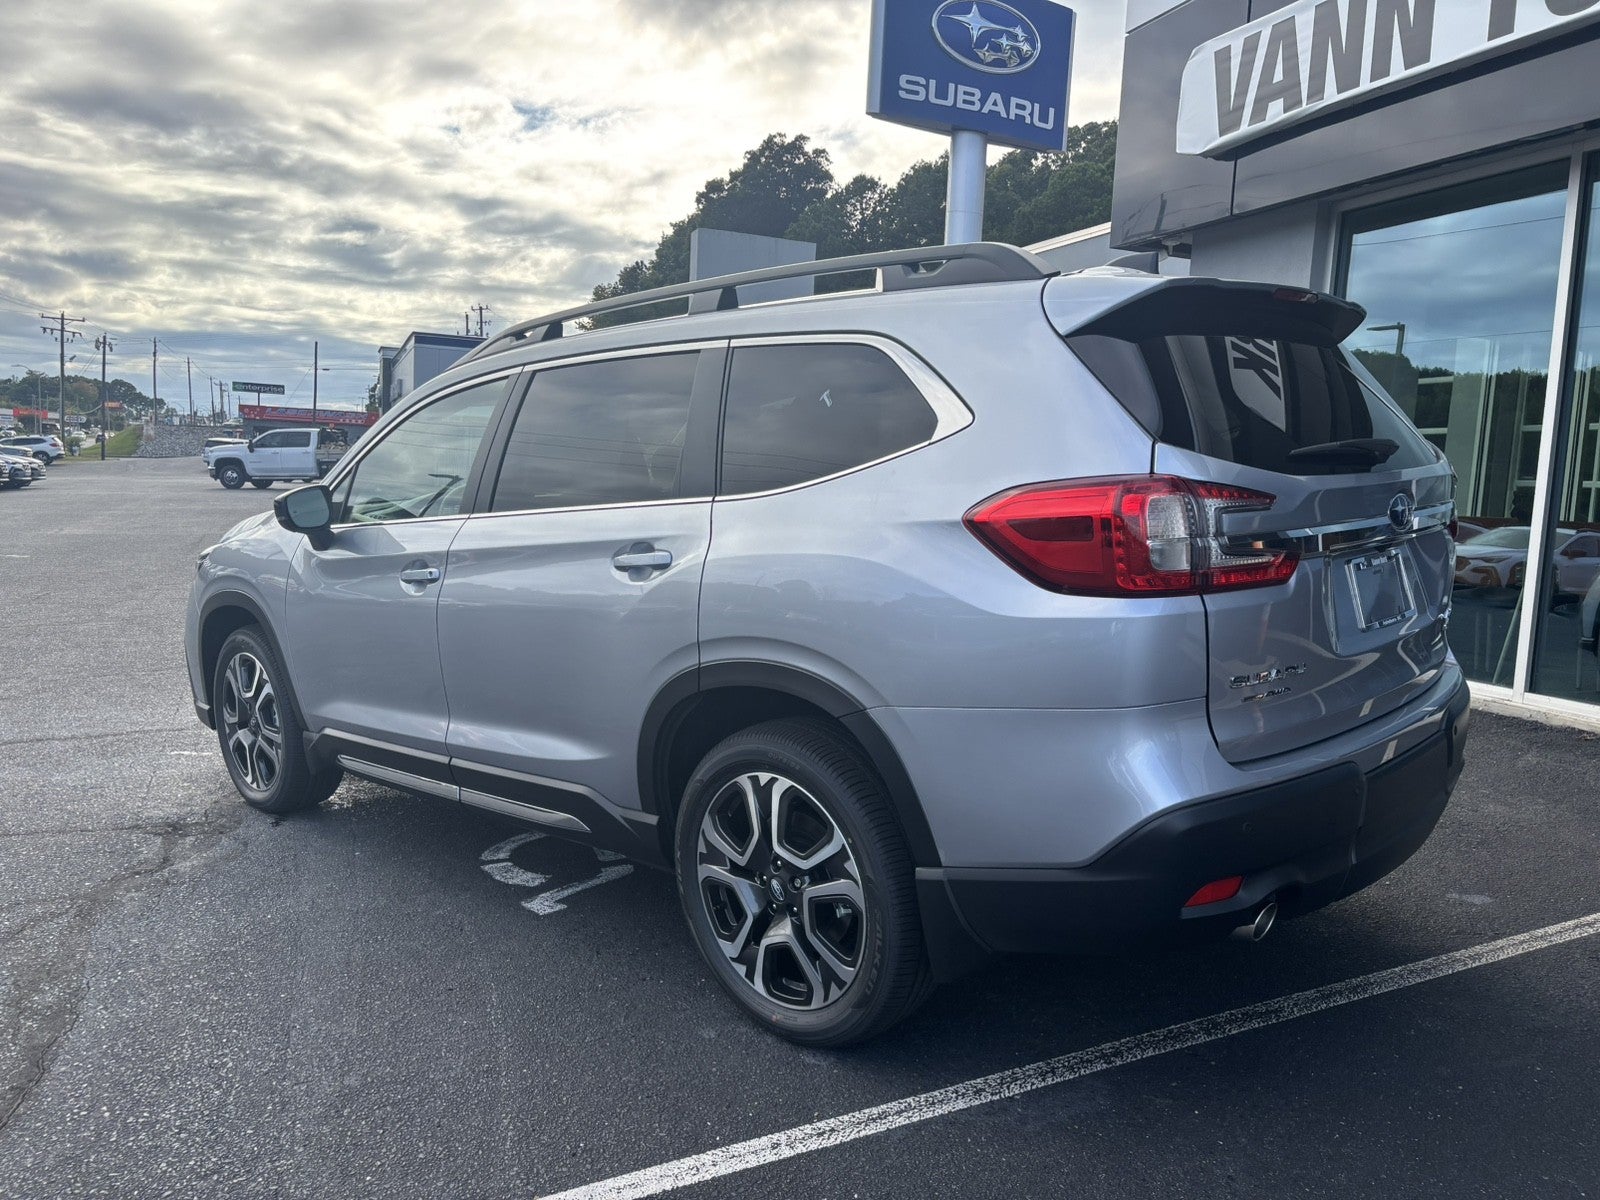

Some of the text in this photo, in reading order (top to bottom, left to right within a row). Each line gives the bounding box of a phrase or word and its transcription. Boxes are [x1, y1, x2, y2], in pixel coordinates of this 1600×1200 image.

[1214, 0, 1435, 137] VANN
[898, 74, 1055, 130] SUBARU
[235, 383, 284, 394] enterprise
[1230, 662, 1307, 688] SUBARU
